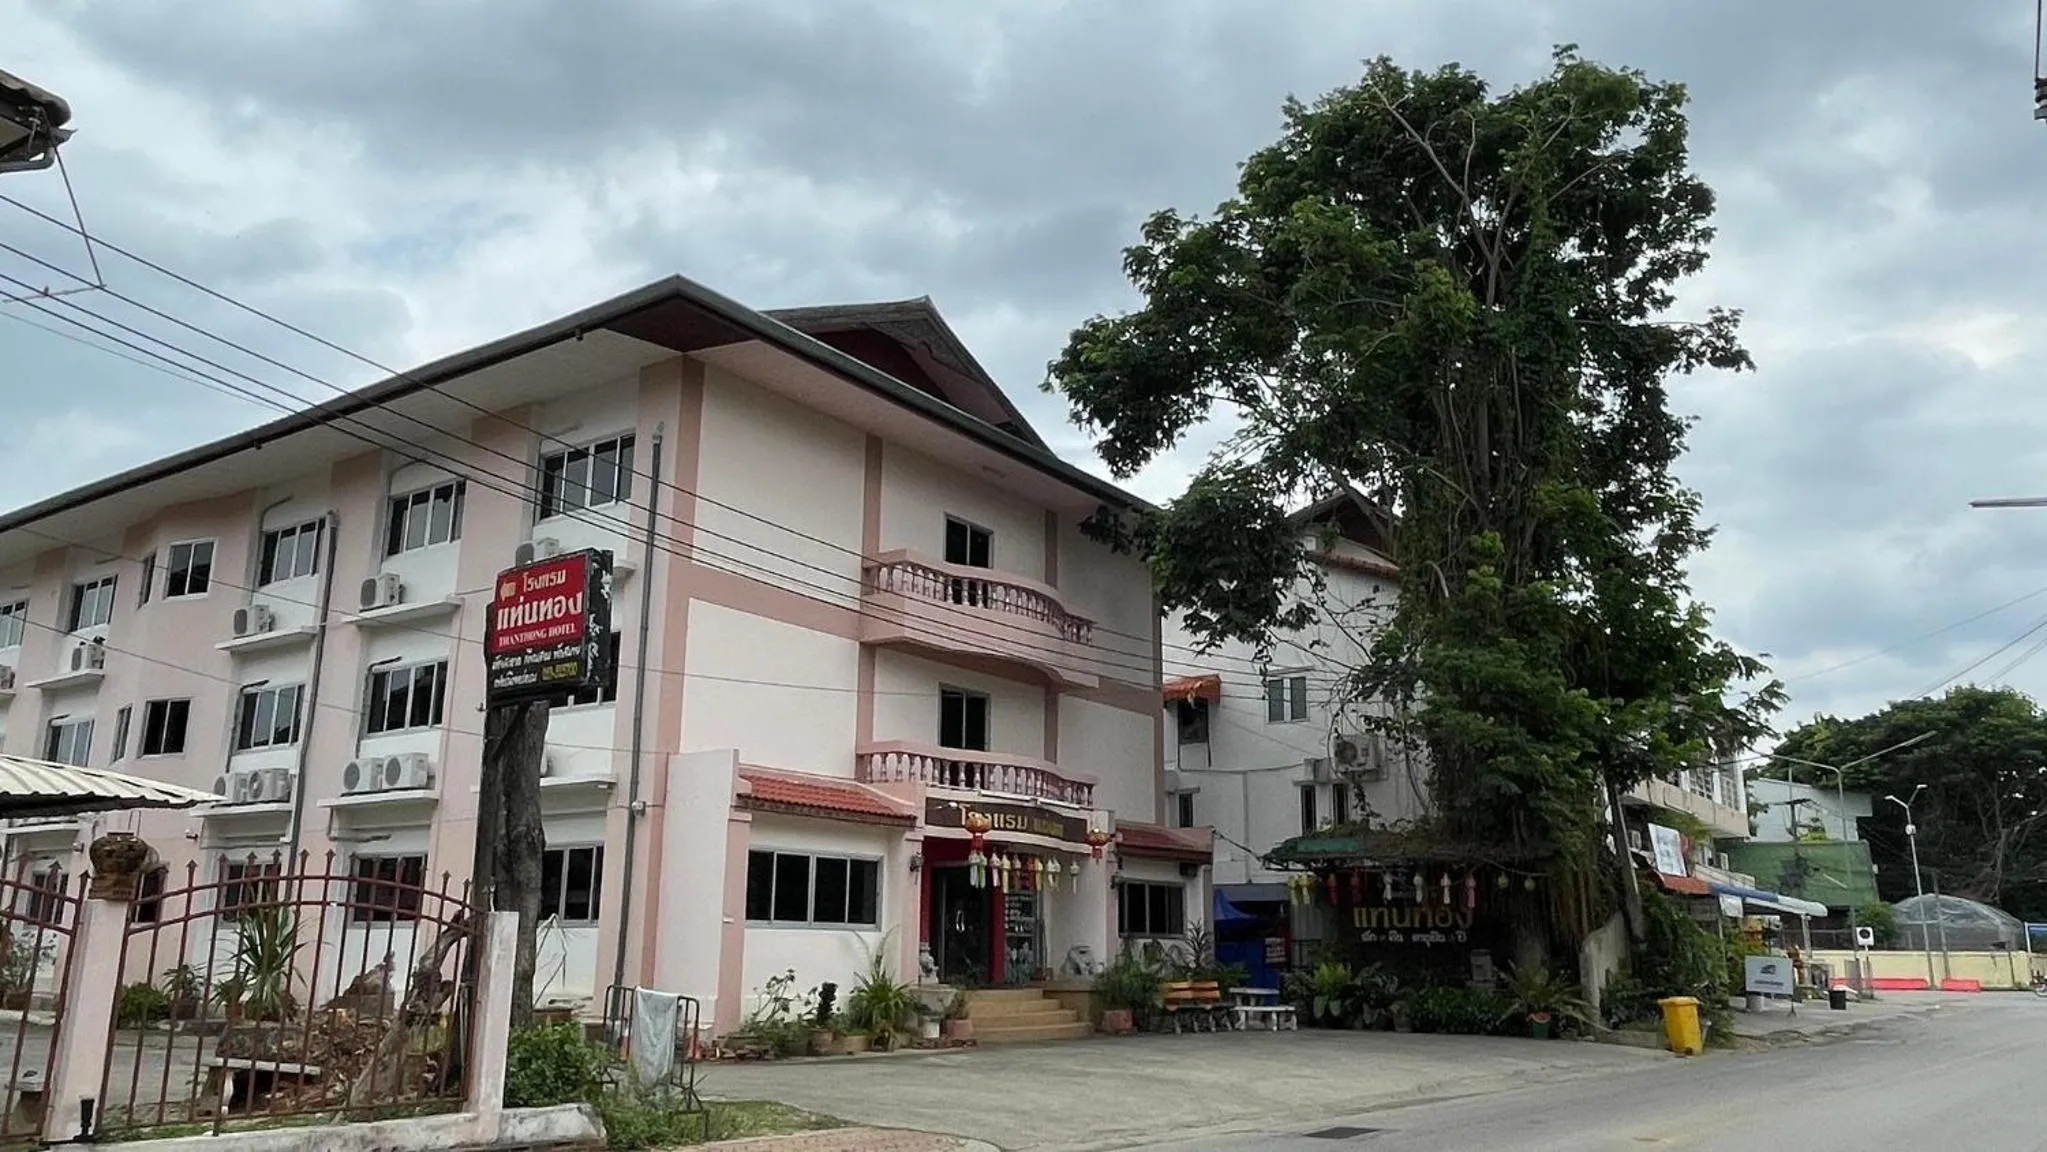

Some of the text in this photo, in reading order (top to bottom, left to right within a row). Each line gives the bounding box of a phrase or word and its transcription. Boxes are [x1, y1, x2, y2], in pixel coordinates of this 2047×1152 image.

[497, 592, 583, 631] แท่นทอง
[548, 623, 575, 637] HOTEL
